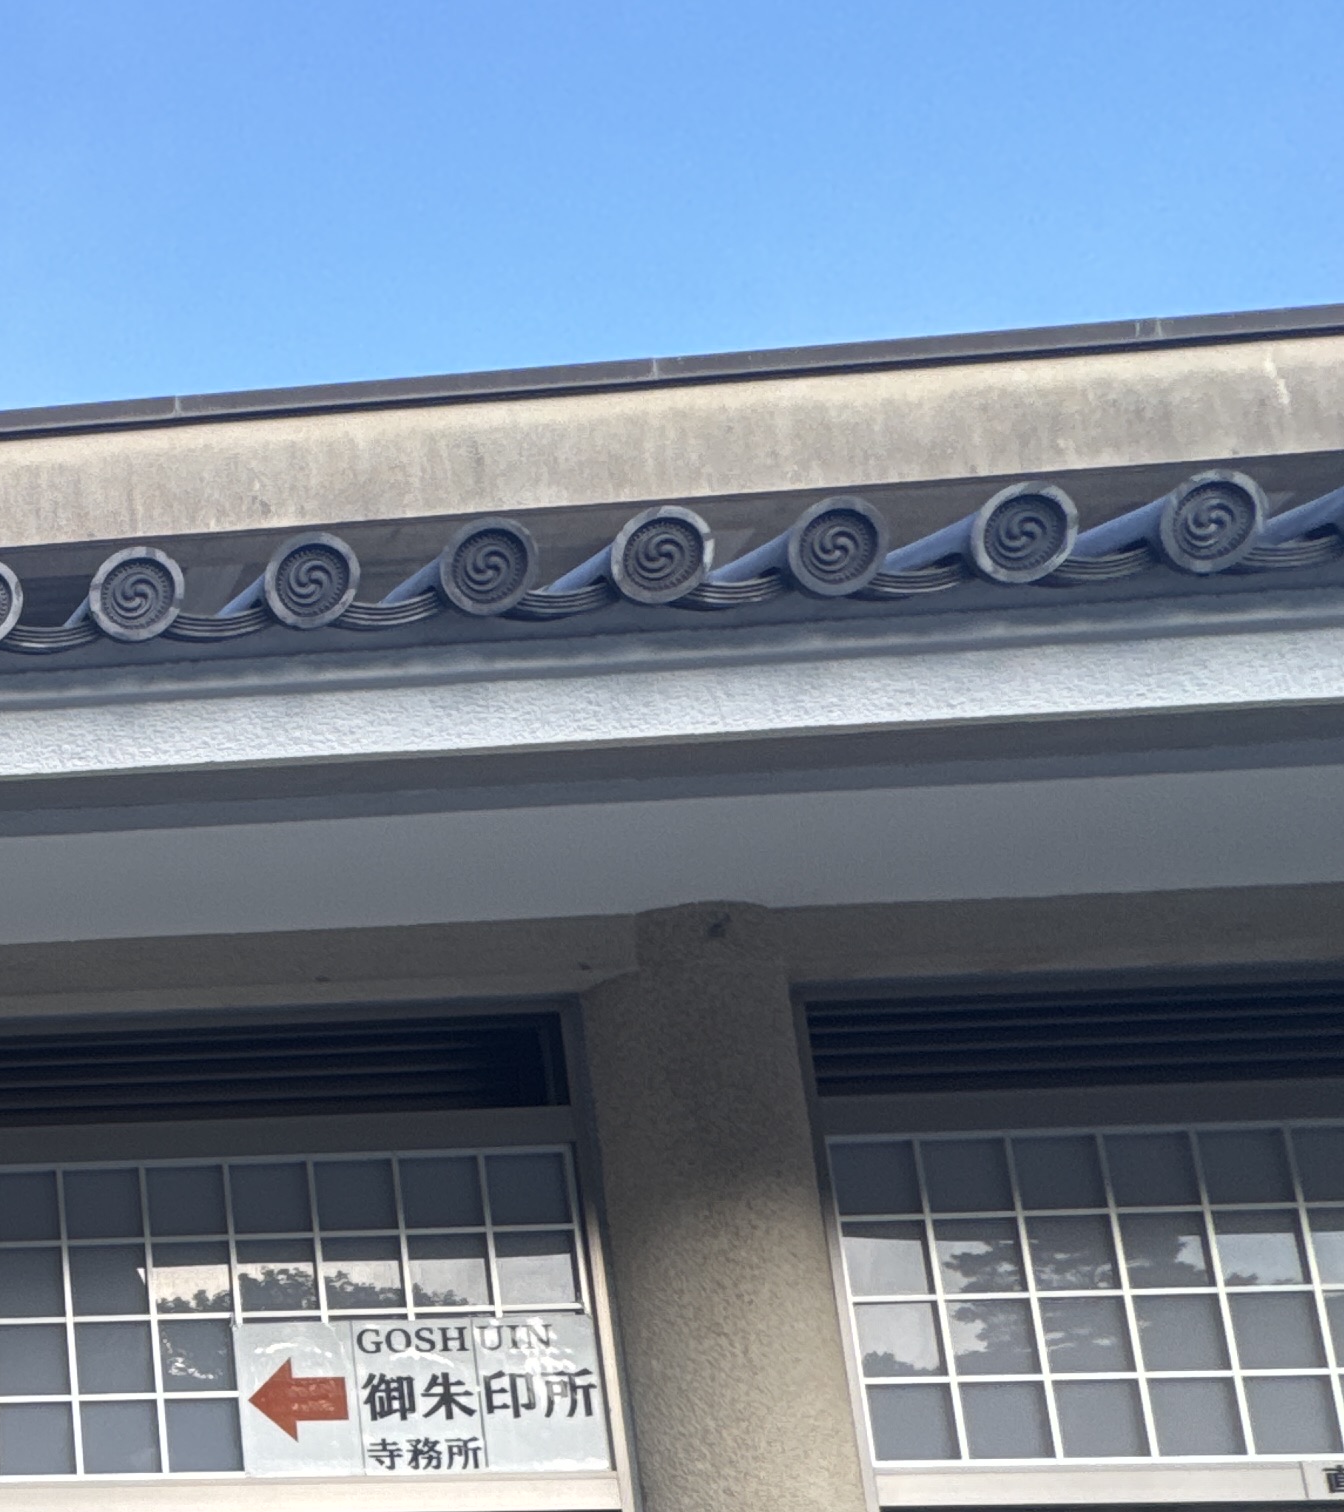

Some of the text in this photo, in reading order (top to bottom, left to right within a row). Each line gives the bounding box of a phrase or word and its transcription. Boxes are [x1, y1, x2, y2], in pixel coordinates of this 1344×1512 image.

[356, 1323, 553, 1354] GOSHUIN
[361, 1367, 598, 1422] 御朱印所
[367, 1436, 483, 1471] 寺務所
